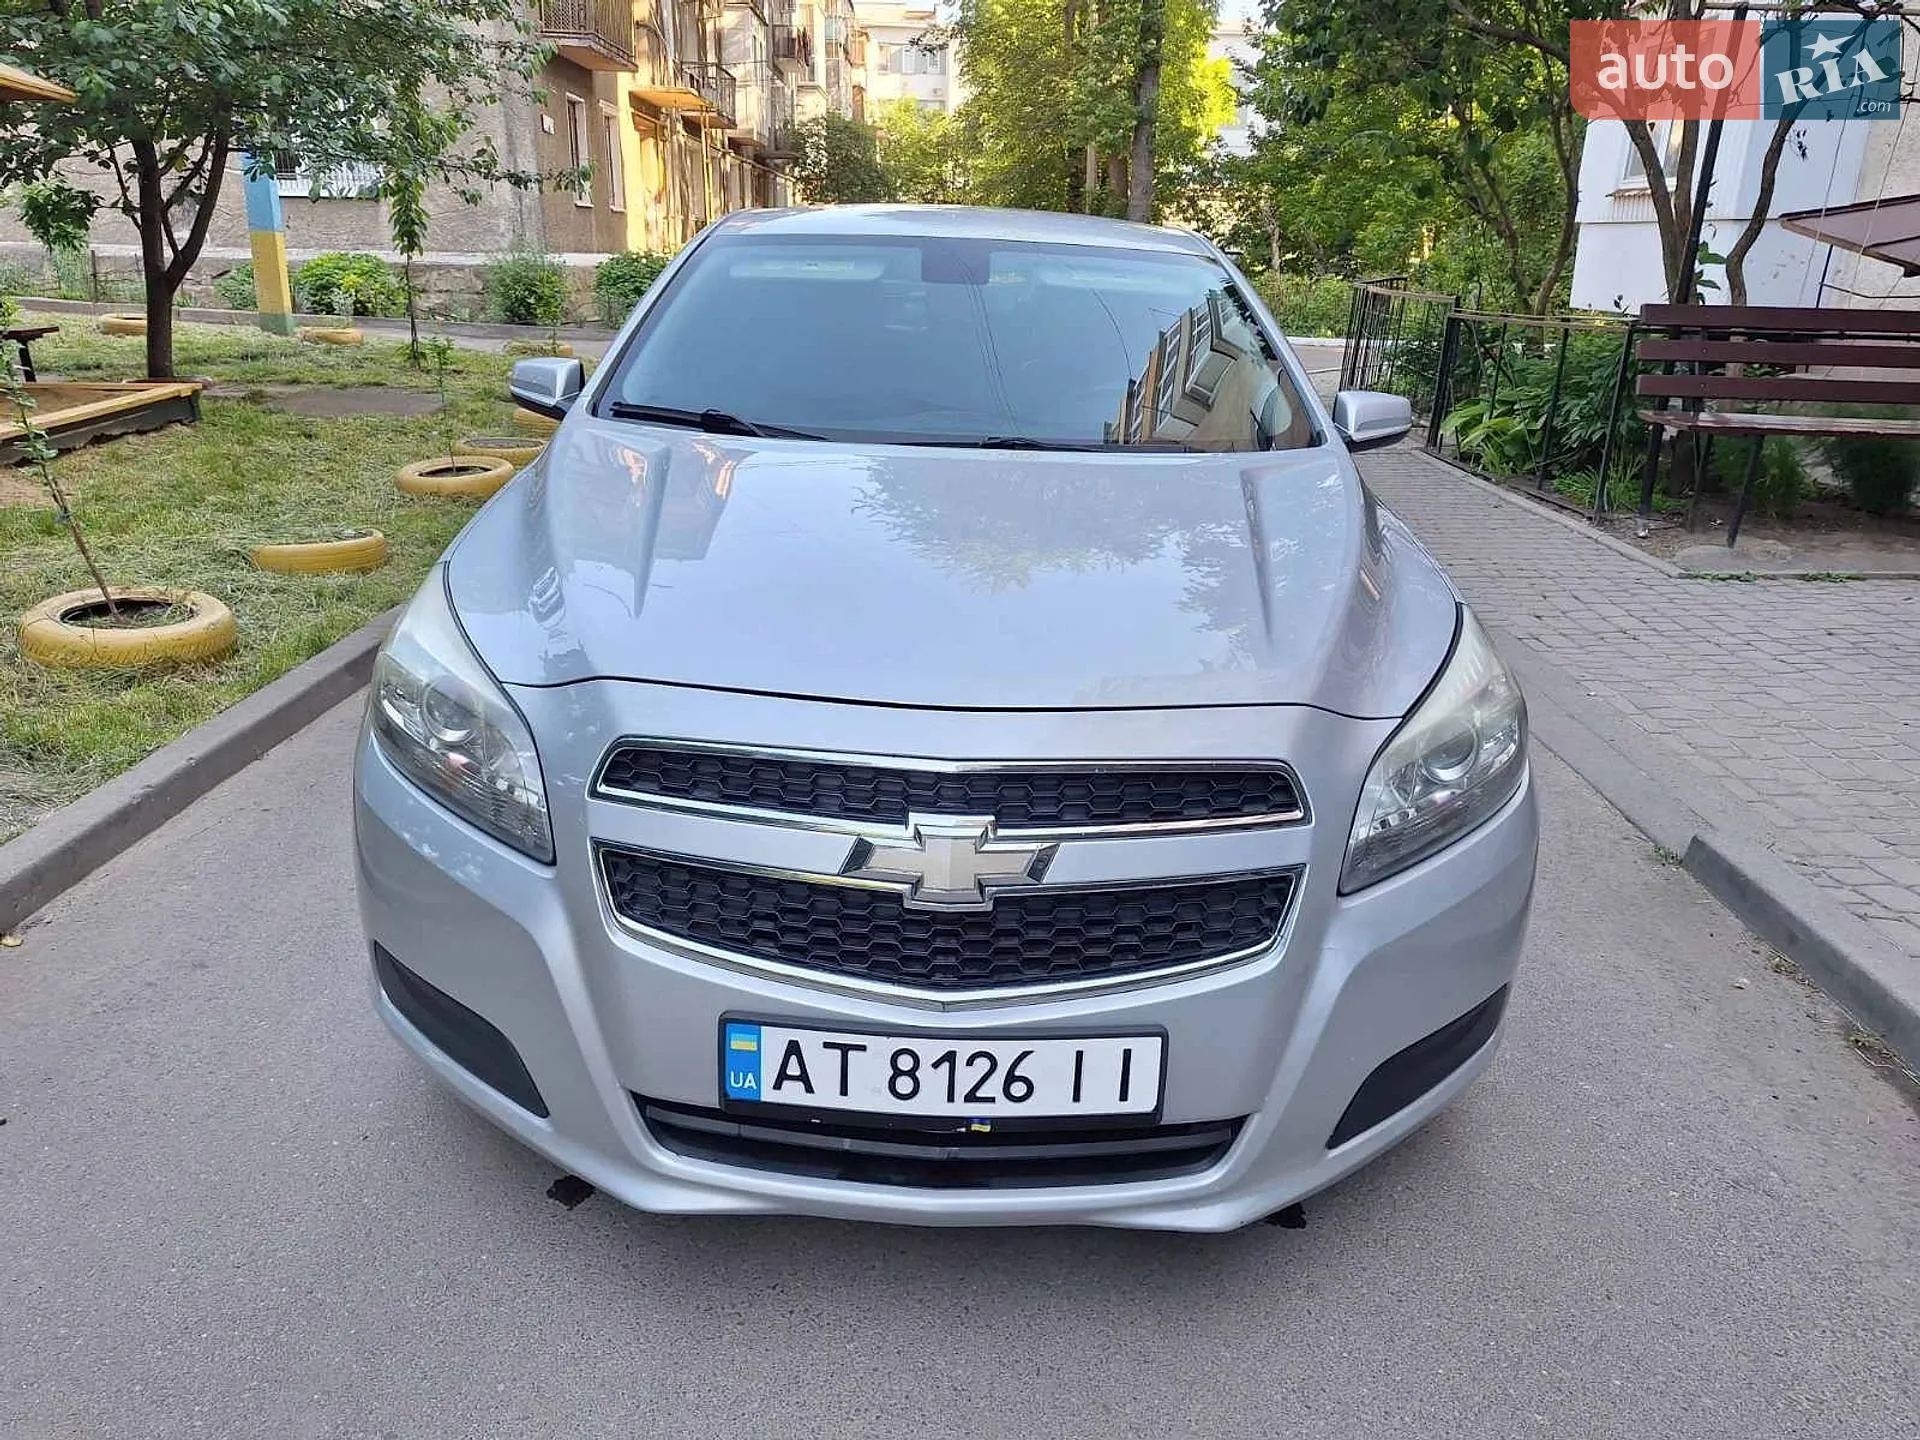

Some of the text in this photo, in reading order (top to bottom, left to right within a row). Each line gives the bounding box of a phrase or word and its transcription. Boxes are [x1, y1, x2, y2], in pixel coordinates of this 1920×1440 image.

[730, 1072, 757, 1091] UA
[772, 1039, 868, 1097] AT
[887, 1047, 1036, 1104] 8126
